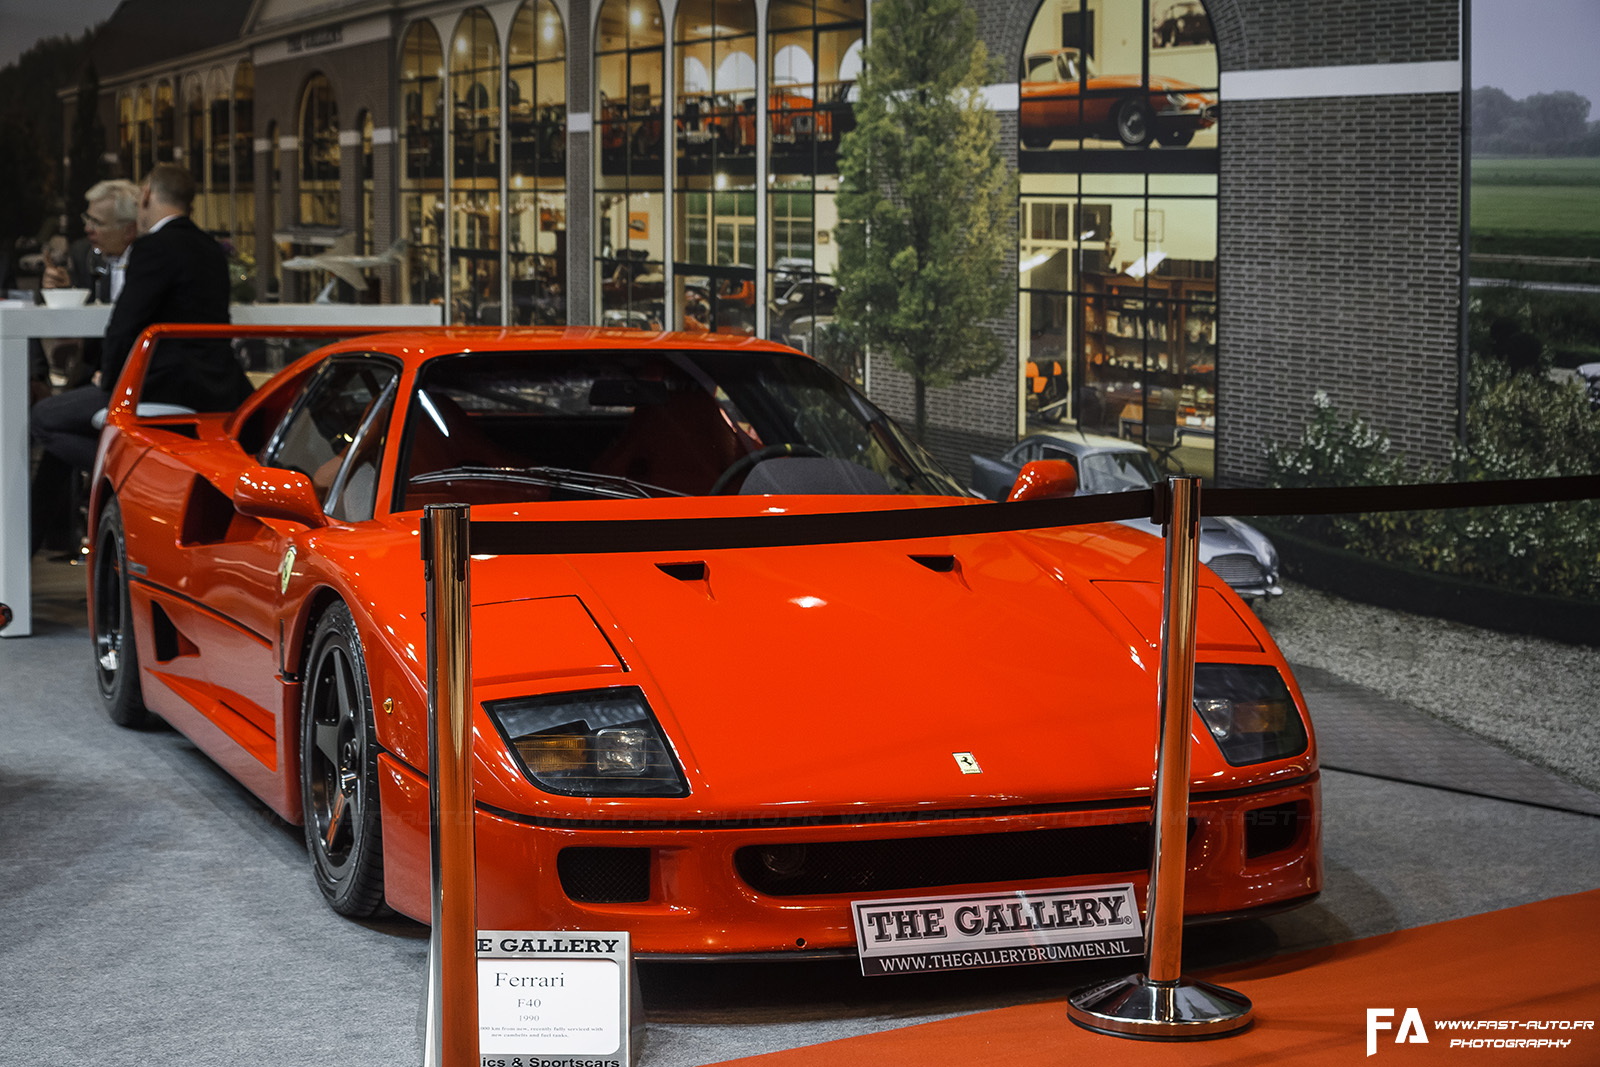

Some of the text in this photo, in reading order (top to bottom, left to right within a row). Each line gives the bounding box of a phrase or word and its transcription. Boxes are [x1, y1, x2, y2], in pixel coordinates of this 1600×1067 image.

[867, 907, 947, 942] THE
[500, 938, 619, 953] GALLERY
[879, 941, 1130, 972] WWW.THEGALLERYBRUMMEN.NL
[495, 972, 565, 987] Ferrari
[517, 998, 542, 1008] F40
[519, 1014, 541, 1022] 1990
[511, 1057, 523, 1067] &
[529, 1057, 620, 1067] Sportscars
